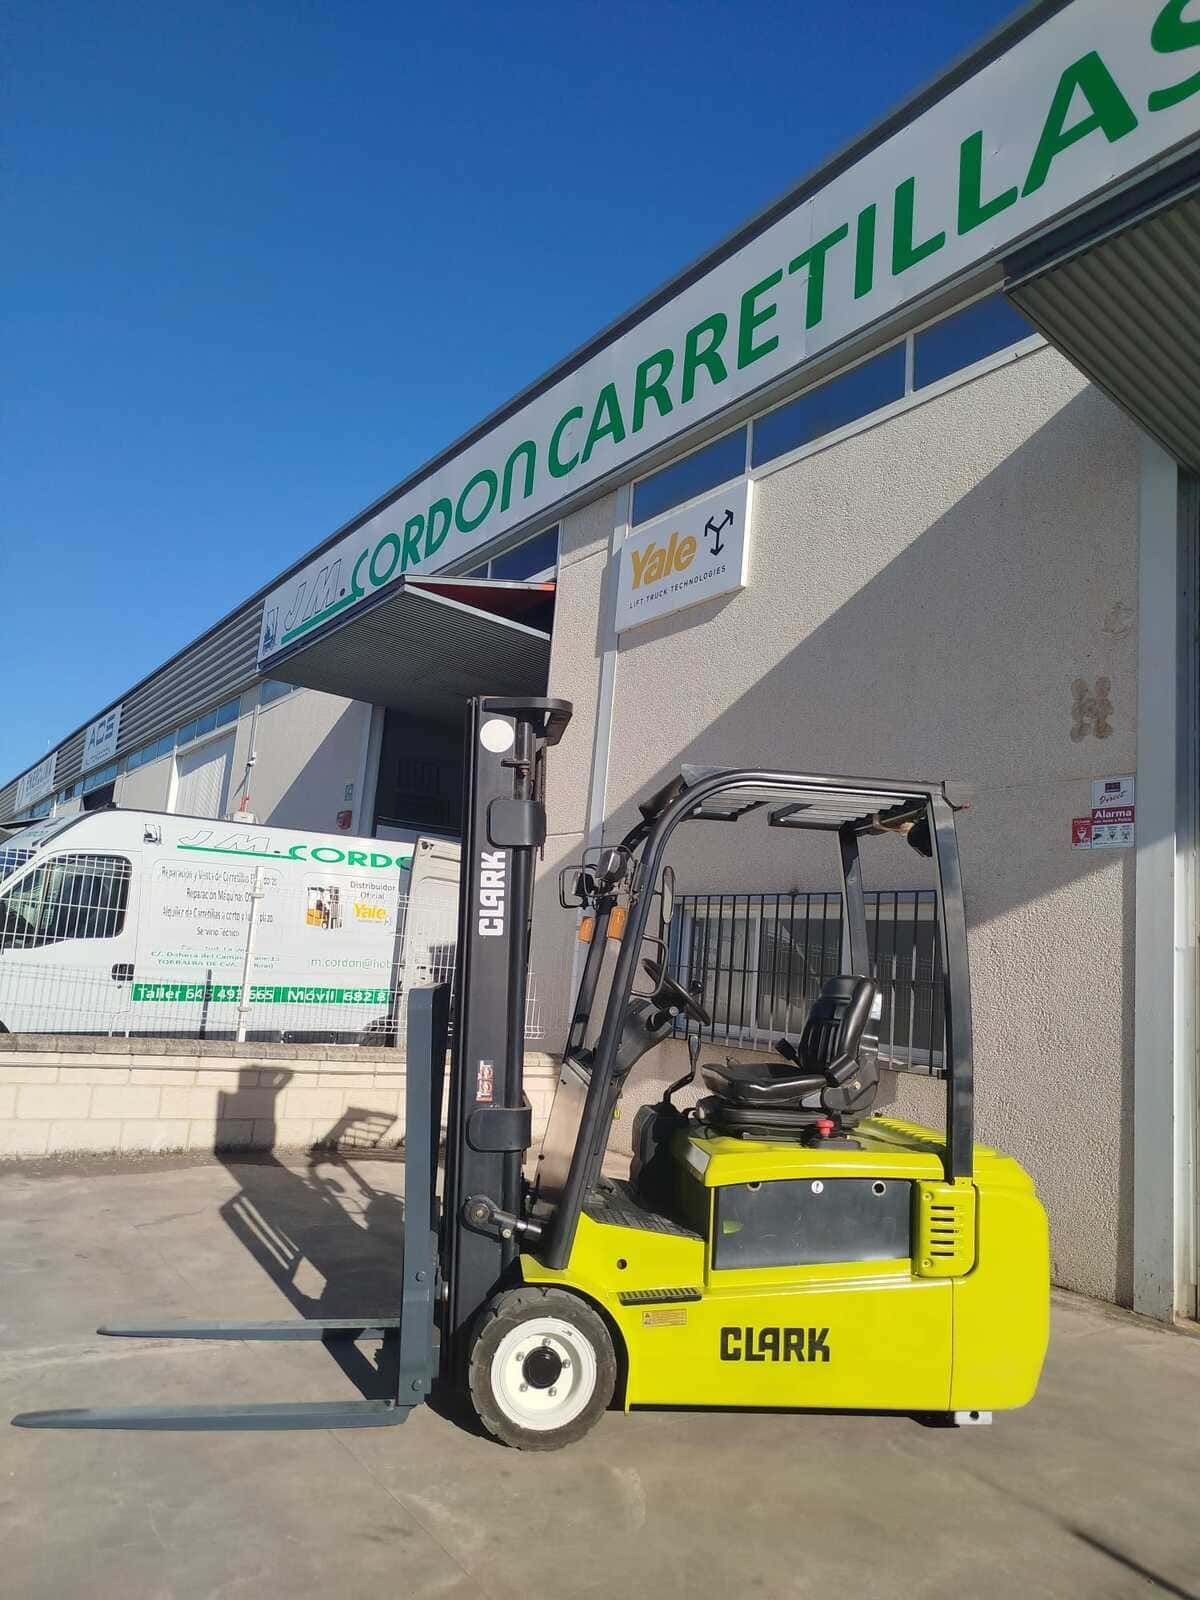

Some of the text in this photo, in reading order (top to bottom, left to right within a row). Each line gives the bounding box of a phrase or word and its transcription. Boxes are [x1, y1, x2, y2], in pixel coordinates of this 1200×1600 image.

[631, 531, 698, 591] Yale
[629, 565, 727, 610] LIFT TRUCK TECHNOLOGIES
[1095, 808, 1132, 820] Alarma
[350, 881, 396, 892] Distribuidor
[478, 851, 507, 937] CLARK
[354, 903, 387, 920] Yale
[138, 986, 181, 1000] Taller
[287, 987, 335, 1001] Móvil
[720, 1327, 830, 1362] CLARK
